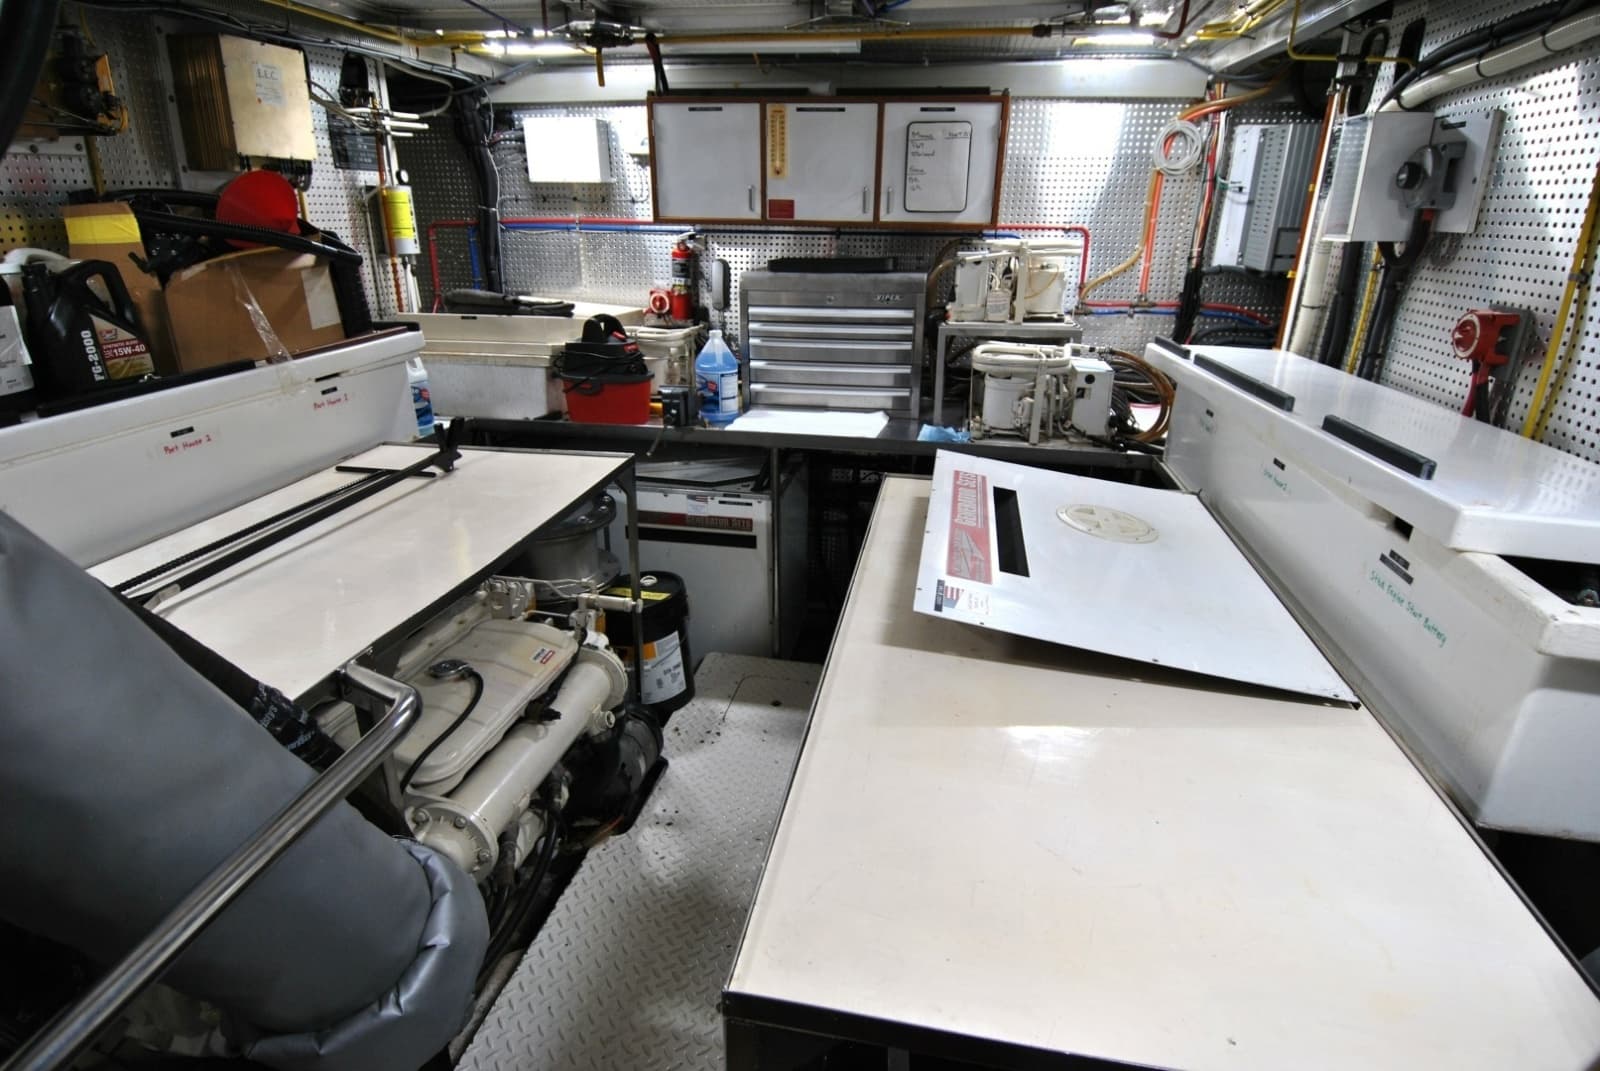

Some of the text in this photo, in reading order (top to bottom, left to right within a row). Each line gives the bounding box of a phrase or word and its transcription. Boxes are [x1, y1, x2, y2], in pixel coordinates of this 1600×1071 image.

[113, 344, 146, 357] 15W-40
[955, 470, 978, 489] SETS
[954, 488, 978, 527] GENERATOR
[1423, 617, 1447, 648] Battery
